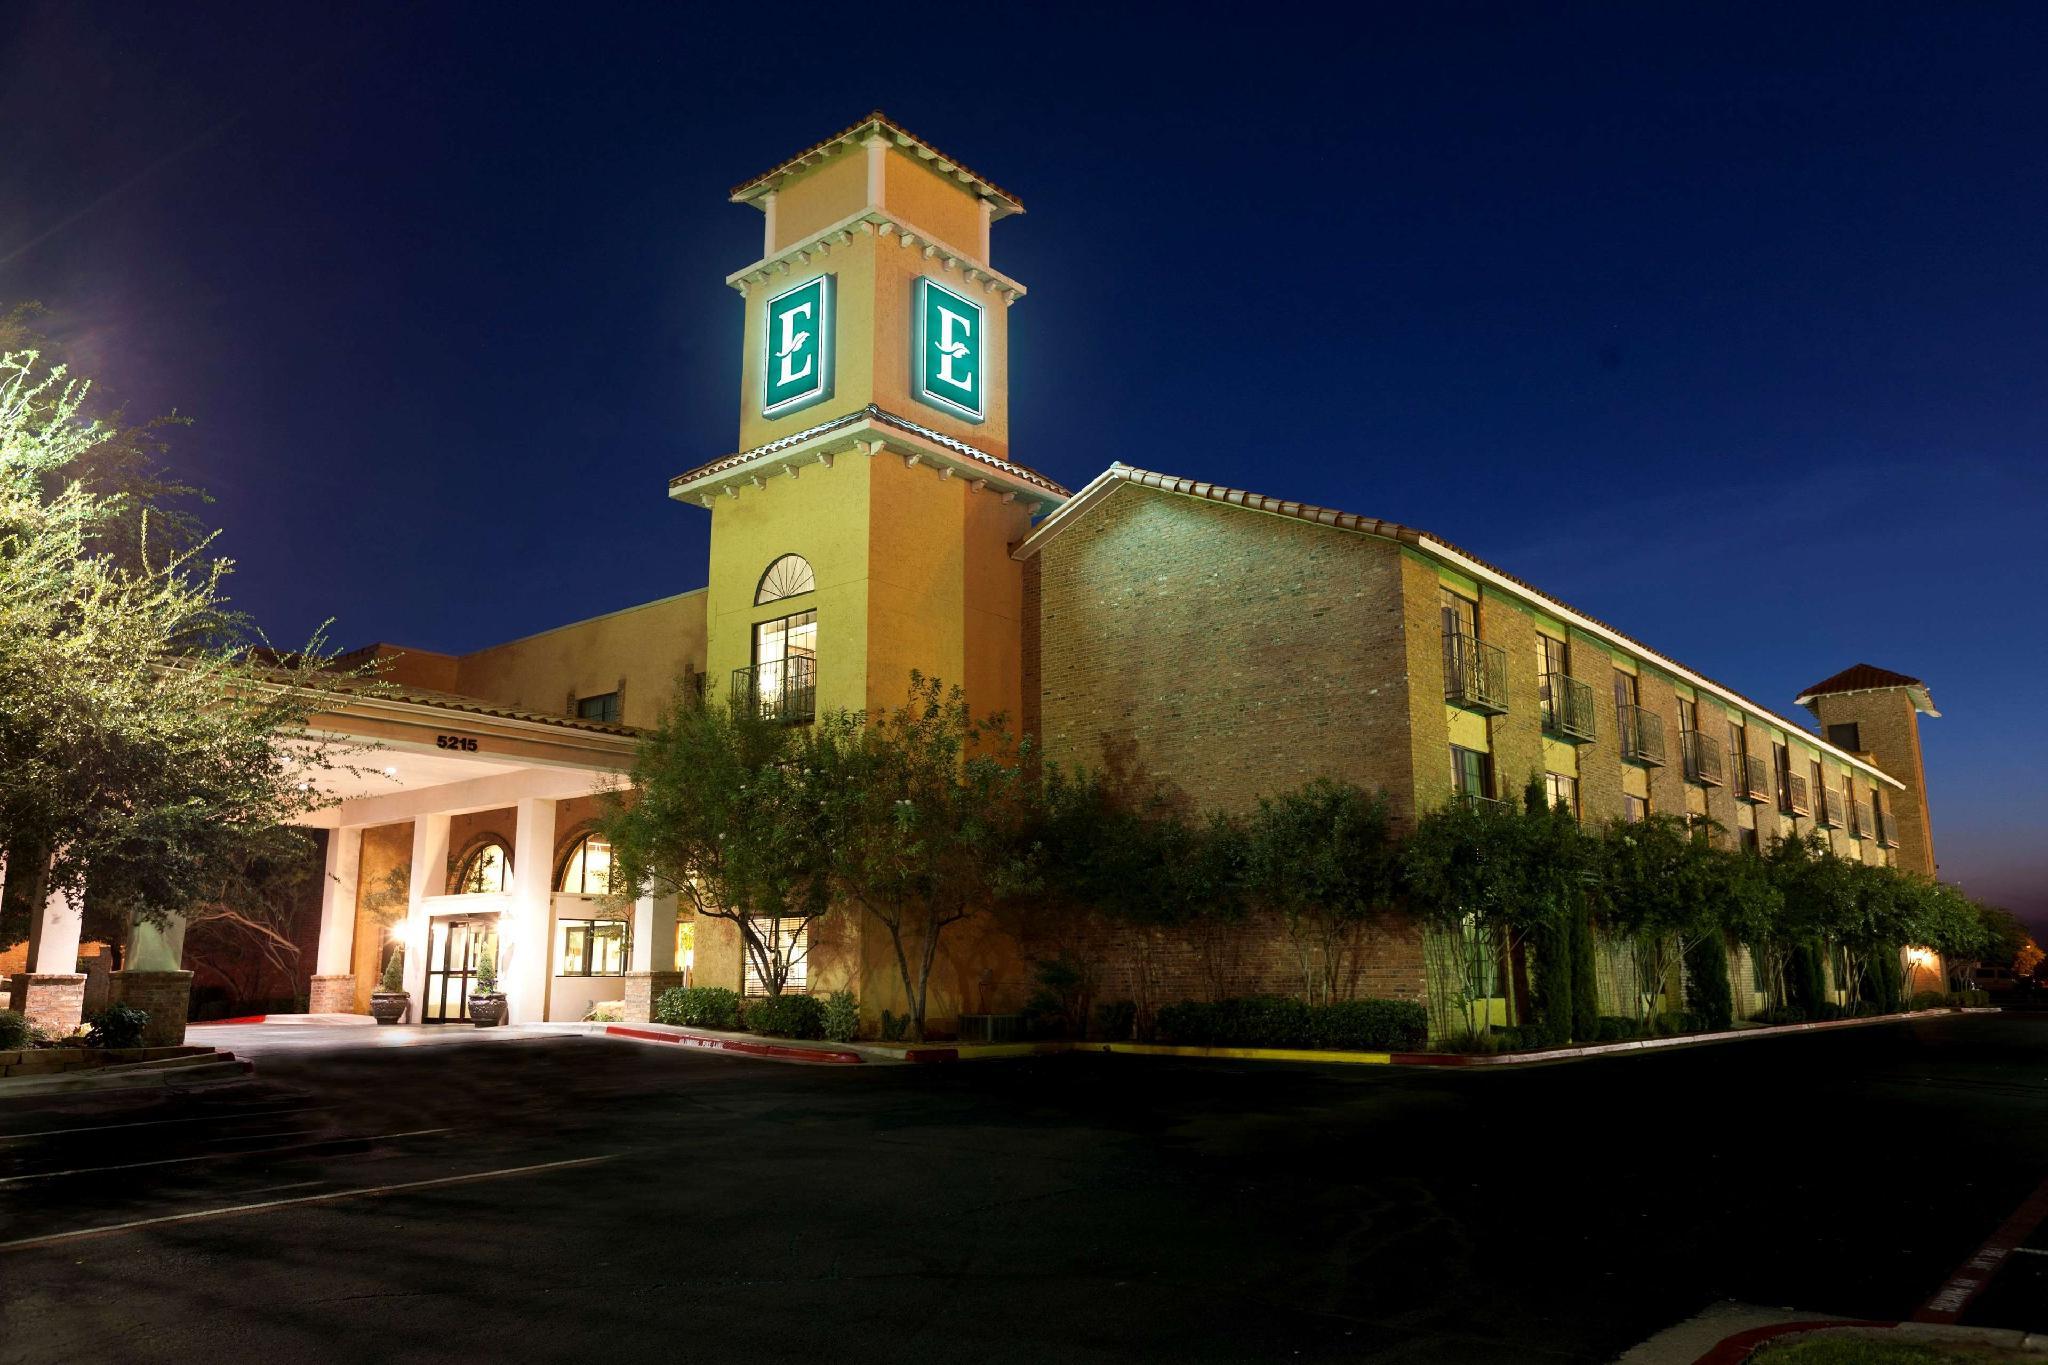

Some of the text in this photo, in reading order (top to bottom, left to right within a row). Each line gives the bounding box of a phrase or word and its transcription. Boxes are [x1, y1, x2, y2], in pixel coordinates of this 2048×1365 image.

[776, 301, 812, 387] E
[935, 305, 972, 392] E
[436, 735, 478, 752] 5215
